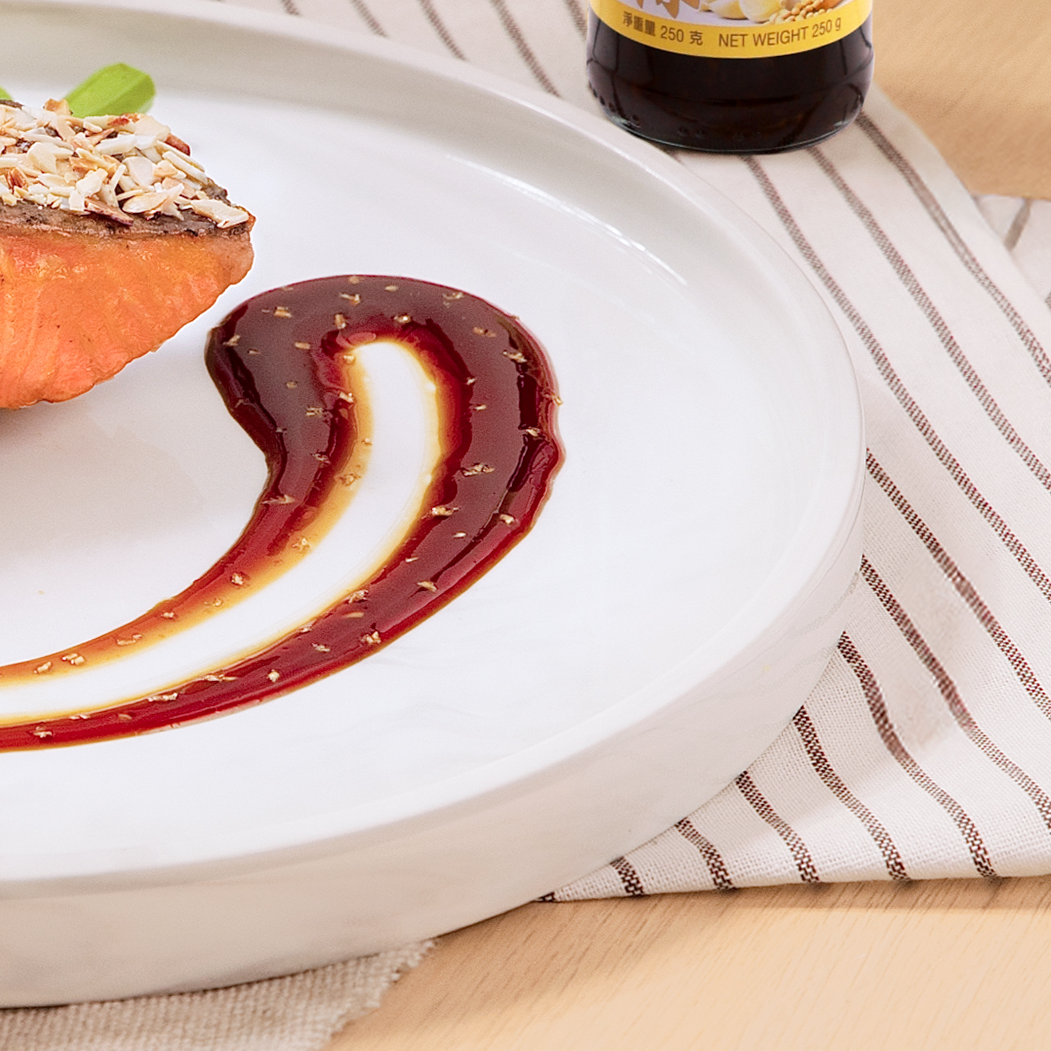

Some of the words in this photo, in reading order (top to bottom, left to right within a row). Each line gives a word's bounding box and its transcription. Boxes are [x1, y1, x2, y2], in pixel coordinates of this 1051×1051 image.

[660, 25, 684, 43] 250
[689, 31, 703, 46] 克
[718, 33, 747, 48] NET
[752, 29, 808, 47] WEIGHT
[811, 21, 833, 38] 250
[835, 17, 842, 31] g
